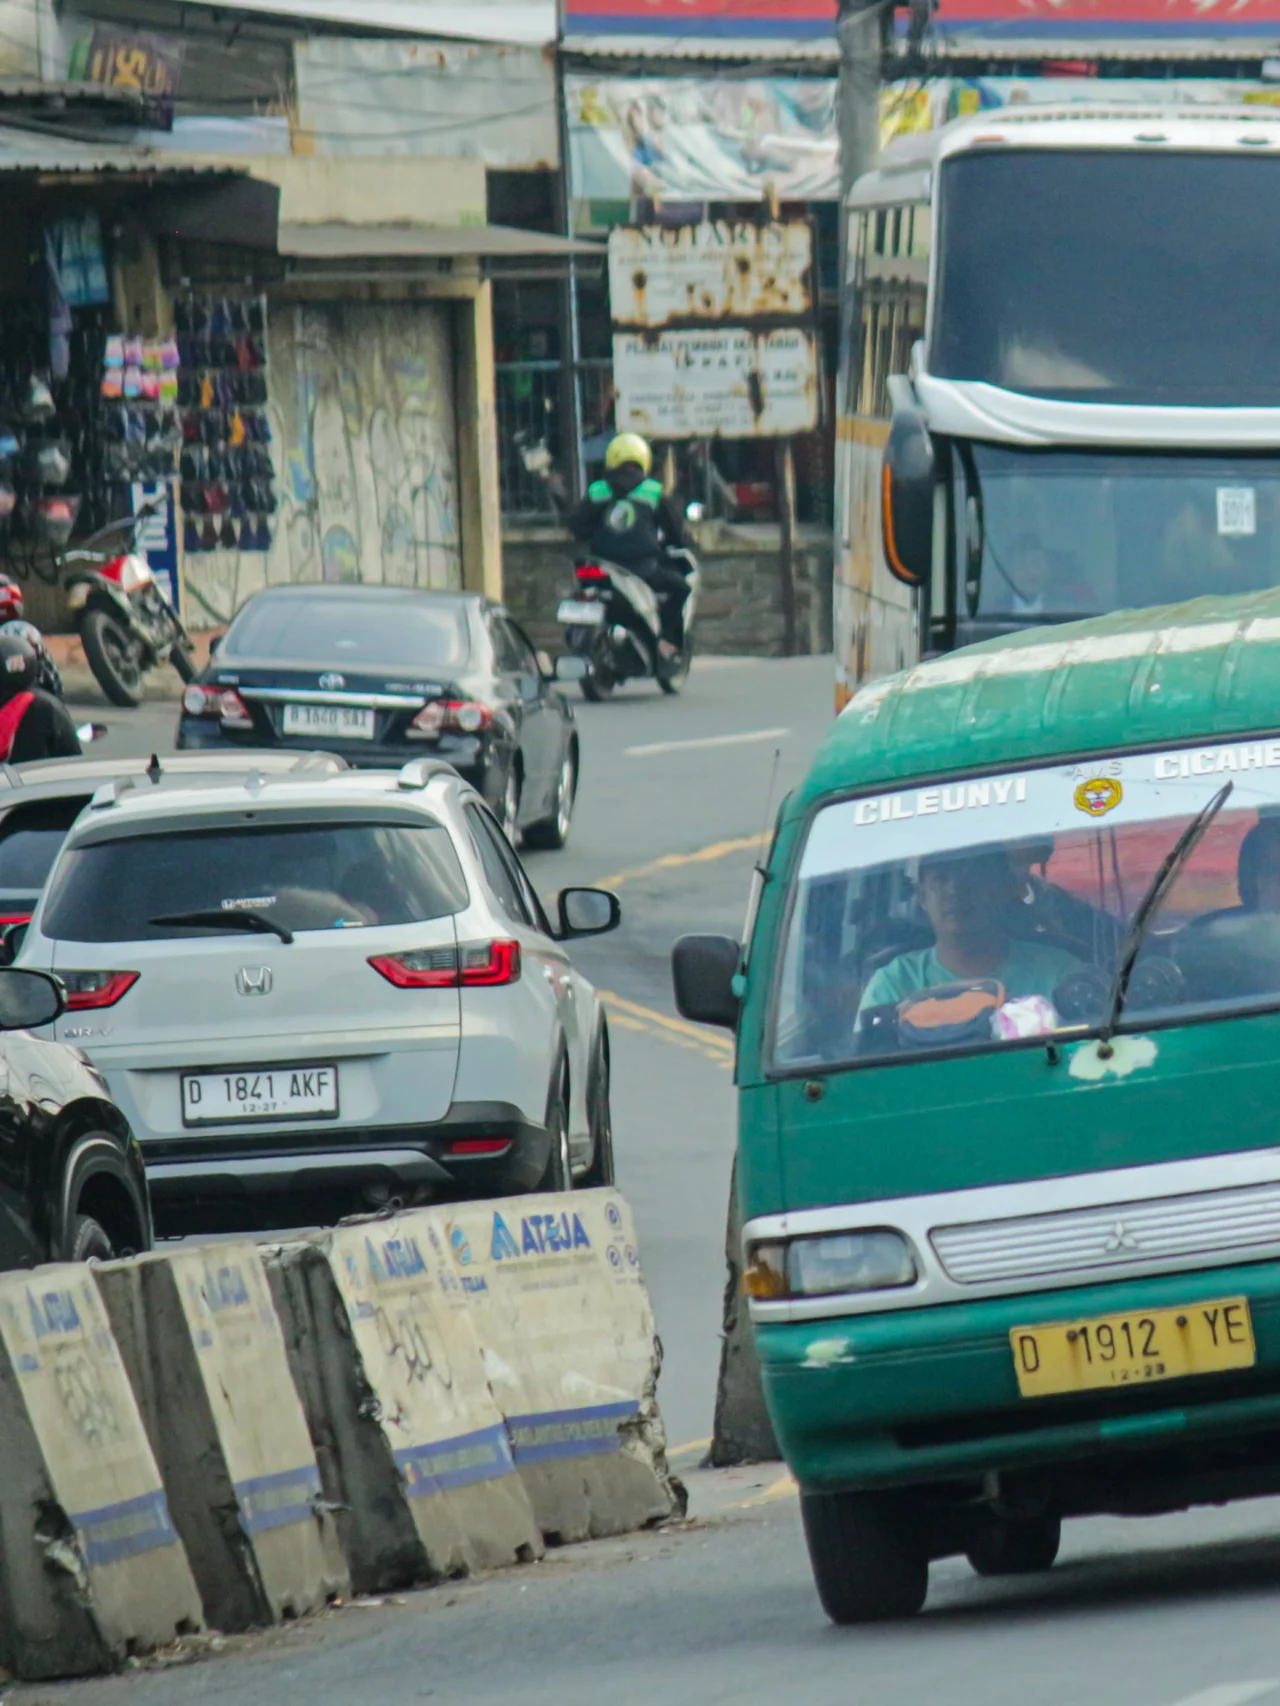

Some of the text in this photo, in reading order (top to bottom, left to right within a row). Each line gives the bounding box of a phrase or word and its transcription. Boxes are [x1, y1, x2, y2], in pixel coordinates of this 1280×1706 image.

[853, 777, 1027, 826] CILEUNYI
[189, 1071, 330, 1104] D 1841 AKF
[1018, 1304, 1246, 1374] D 1912 YE
